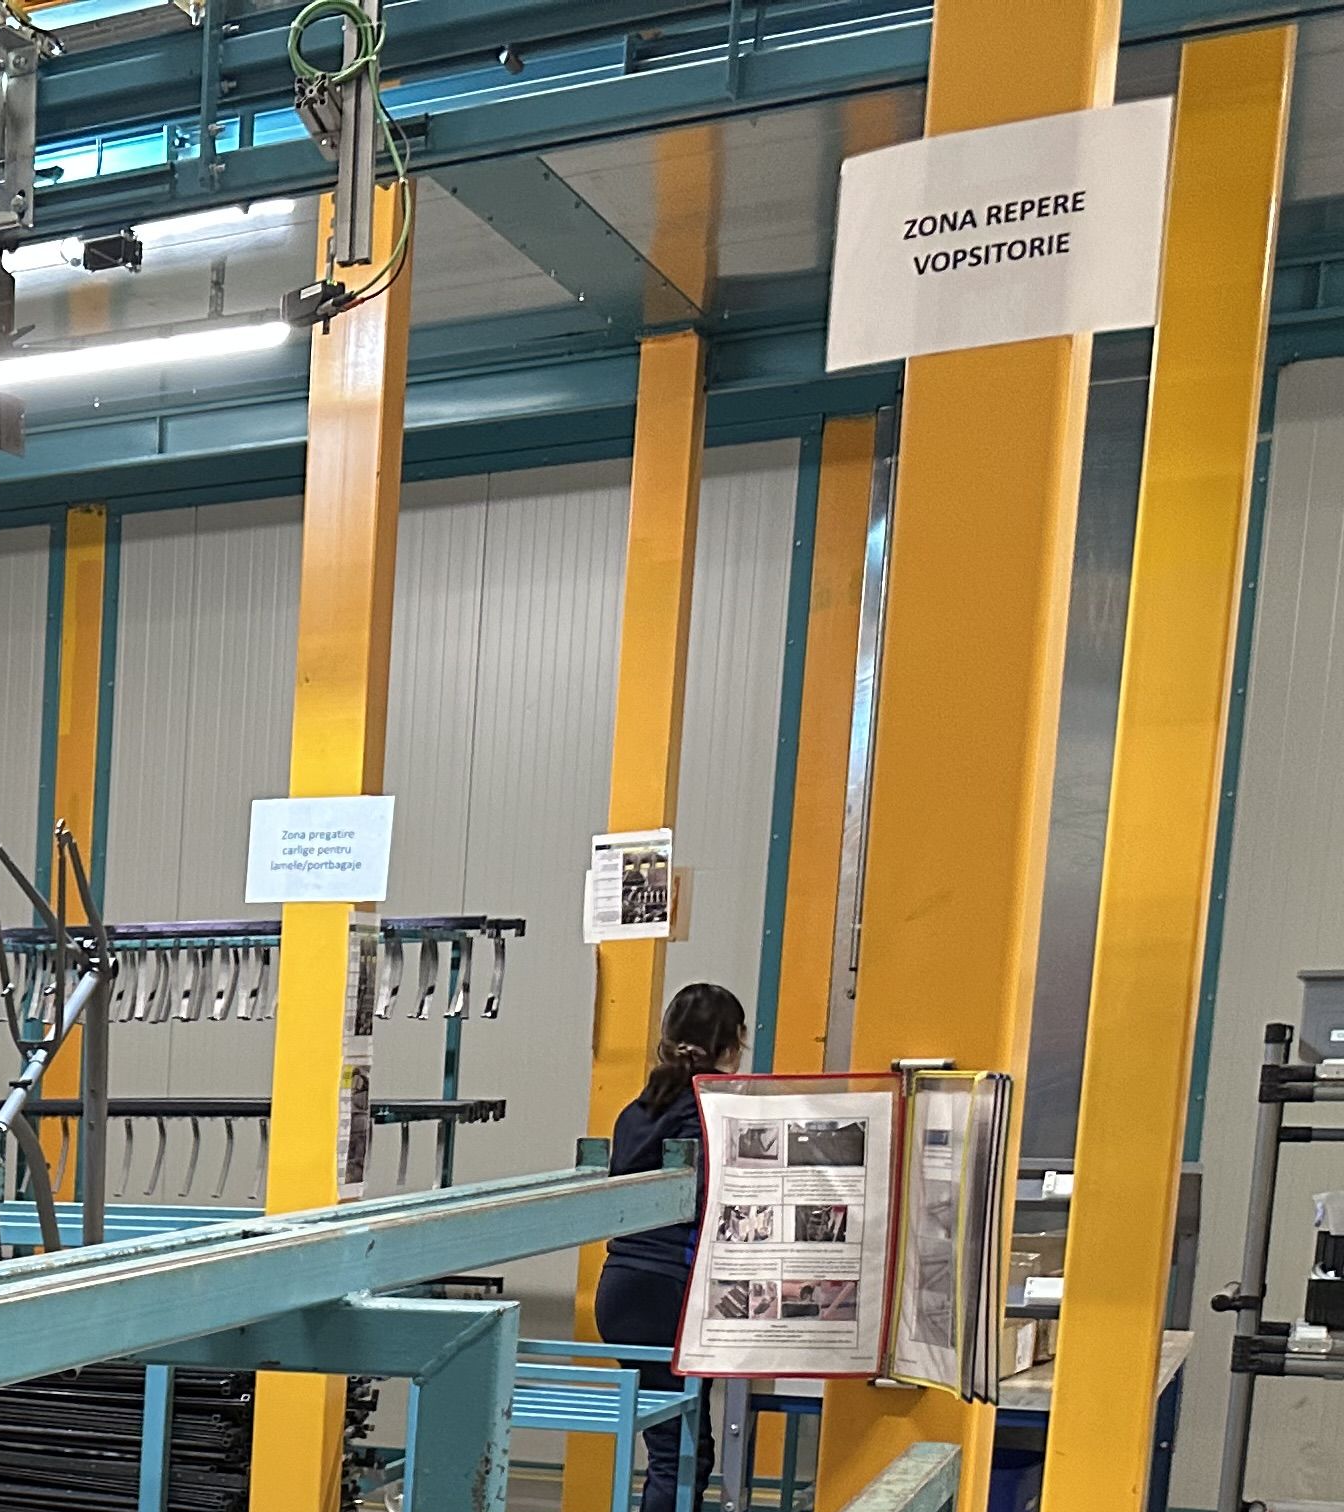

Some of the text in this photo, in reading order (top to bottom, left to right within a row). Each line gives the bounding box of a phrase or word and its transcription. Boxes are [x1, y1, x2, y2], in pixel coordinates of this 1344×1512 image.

[903, 191, 1086, 239] ZONA REPERE
[914, 232, 1070, 275] VOPSITORIE
[281, 830, 355, 841] Zona pregatire
[317, 846, 351, 856] pentru
